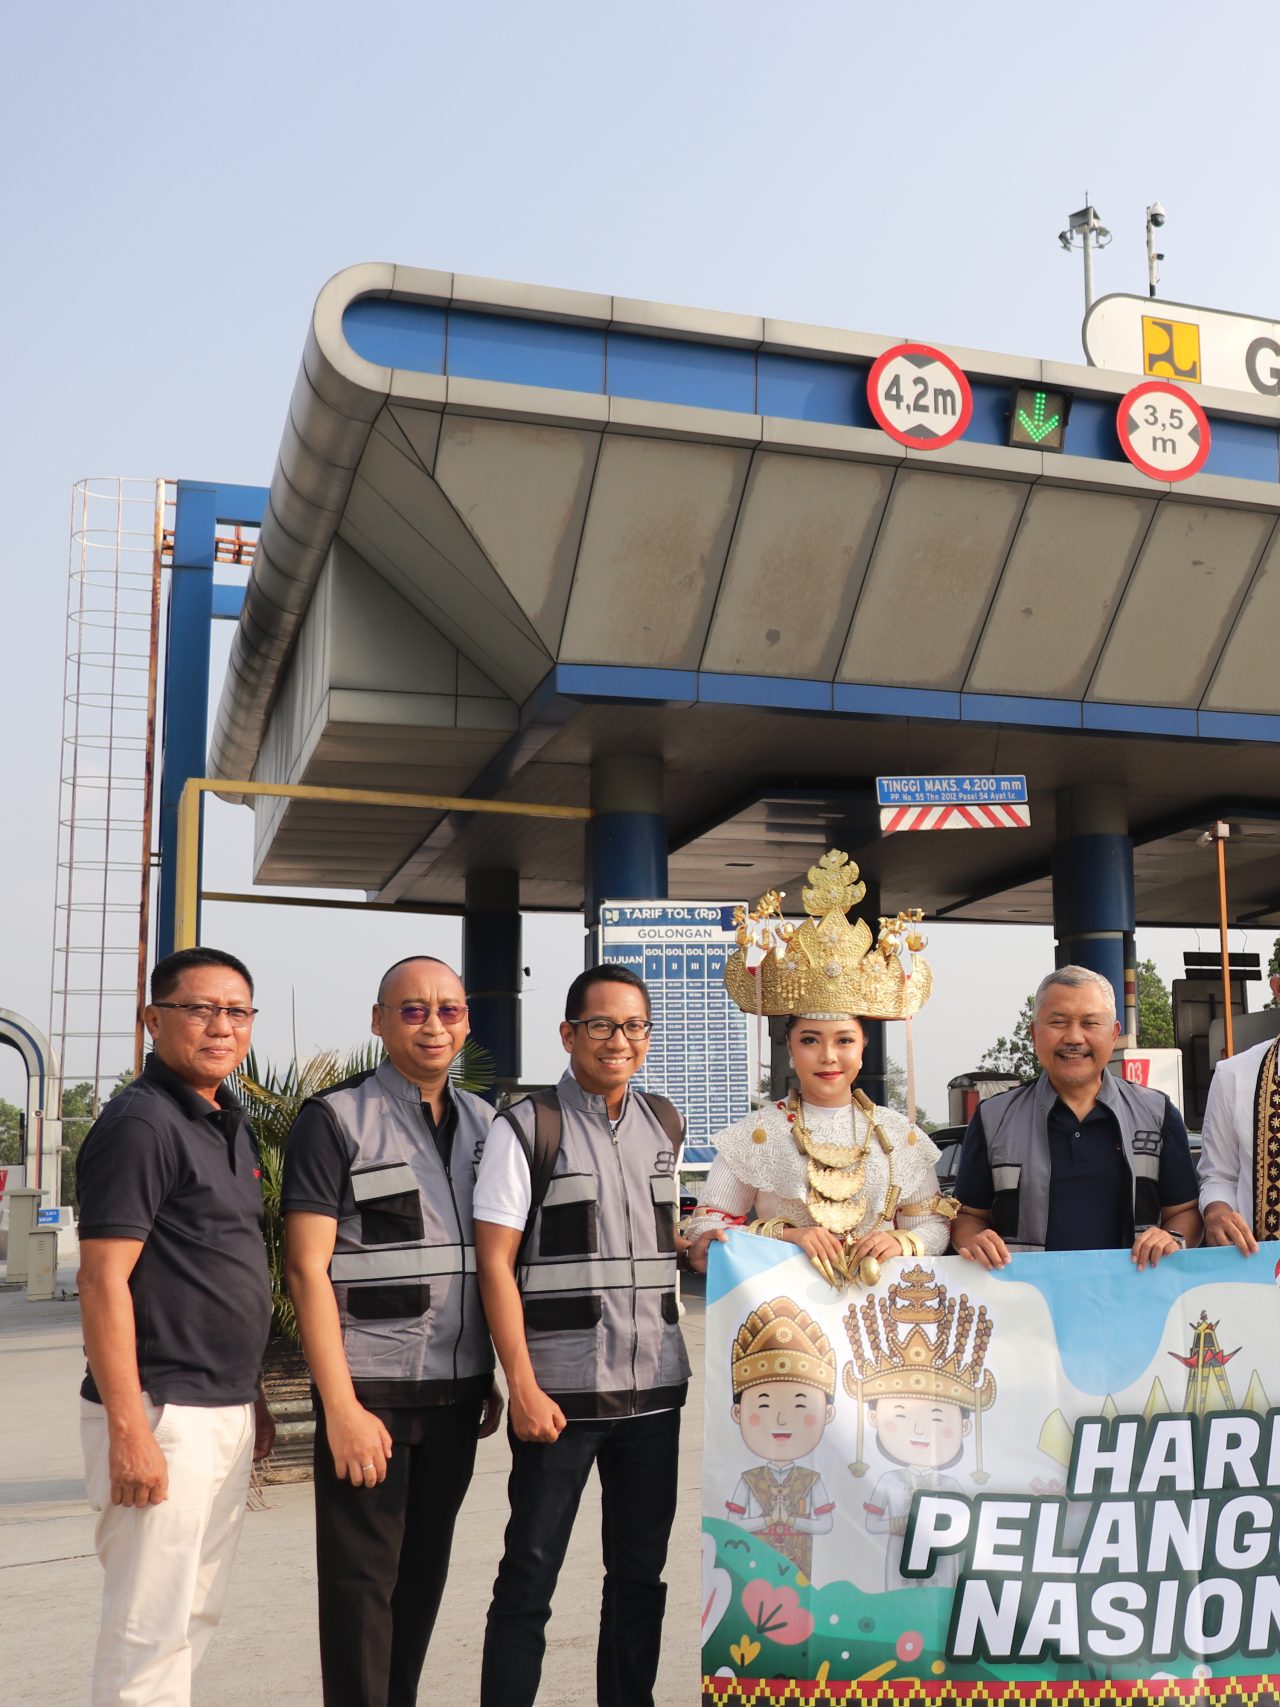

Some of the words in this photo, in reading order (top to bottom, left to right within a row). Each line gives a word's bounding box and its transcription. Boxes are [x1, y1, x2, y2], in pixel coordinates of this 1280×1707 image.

[884, 374, 957, 416] 4,2m
[1144, 404, 1184, 432] 3,5
[1152, 435, 1177, 455] m
[882, 780, 920, 792] TINGGI
[925, 779, 960, 791] MAKS.
[963, 779, 997, 791] 4.200
[1001, 780, 1021, 790] mm
[624, 908, 663, 919] TARIF
[666, 908, 691, 919] TOL
[694, 908, 722, 920] (Rp)
[638, 929, 712, 938] GOLONGAN
[604, 956, 642, 964] TUJUAN
[1127, 1062, 1143, 1084] 03
